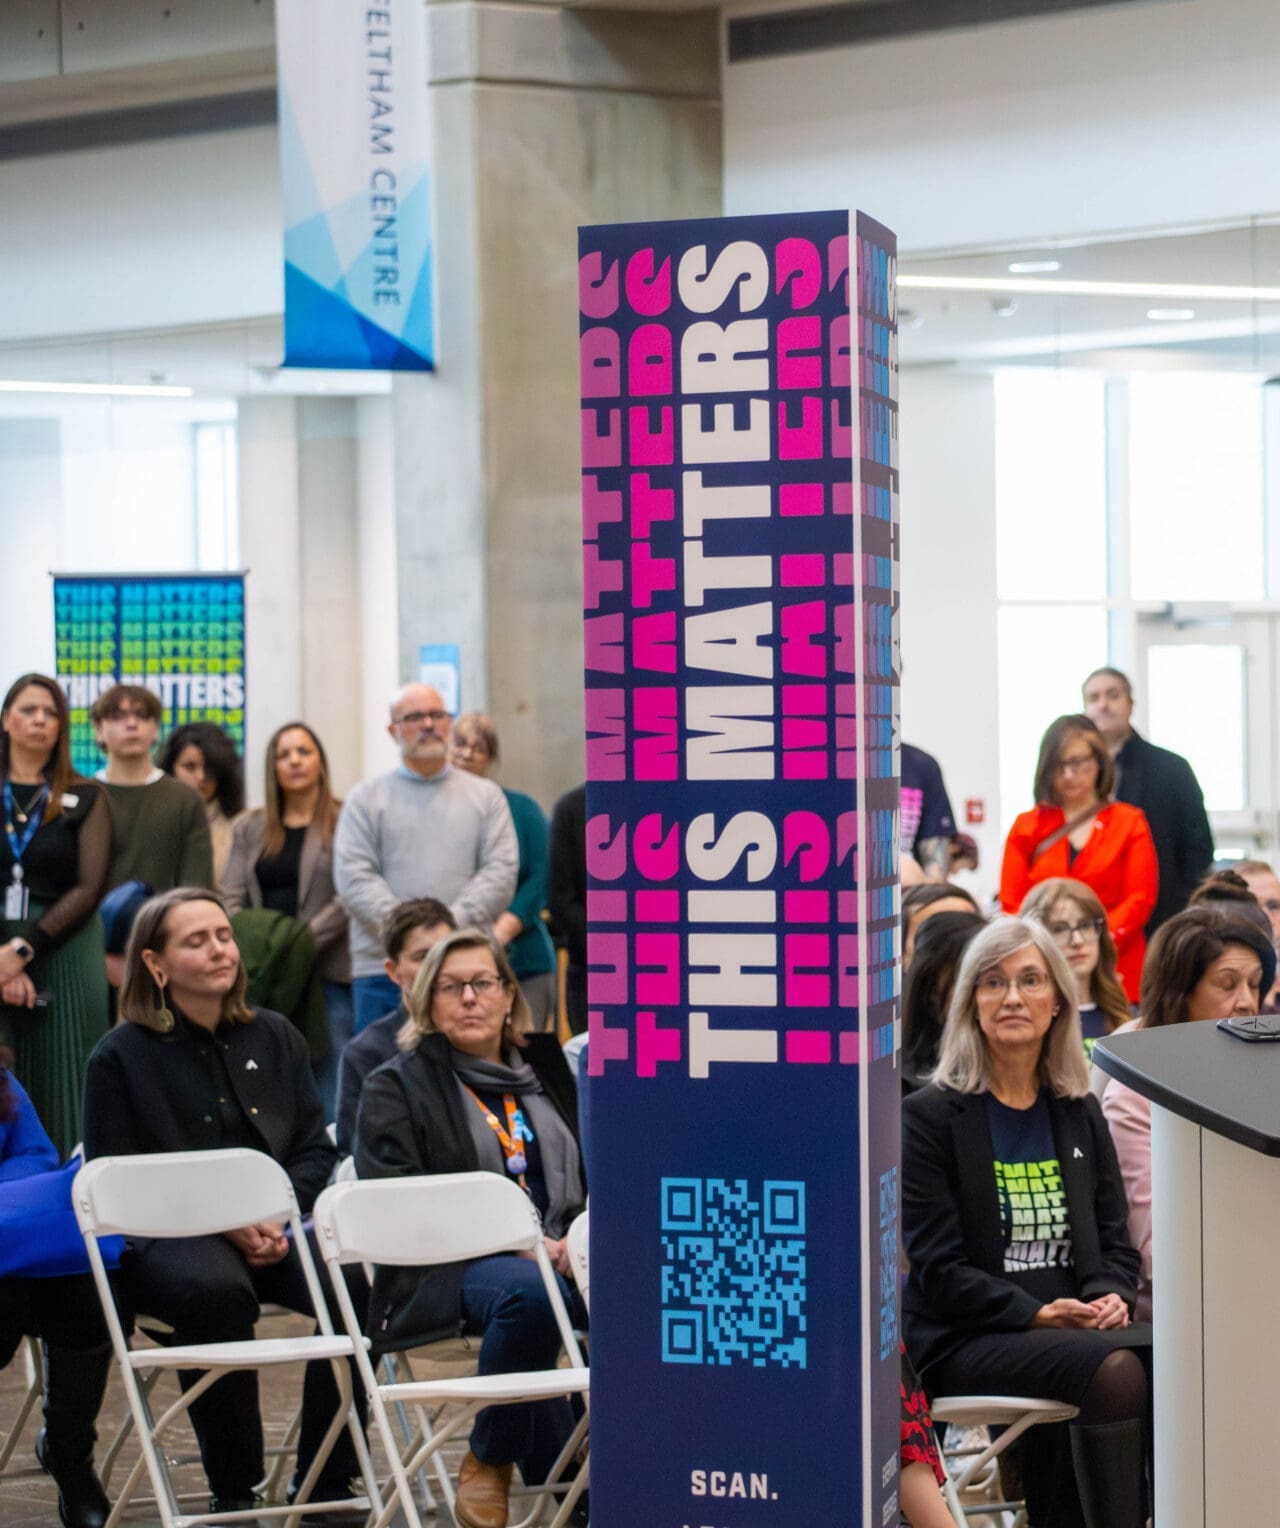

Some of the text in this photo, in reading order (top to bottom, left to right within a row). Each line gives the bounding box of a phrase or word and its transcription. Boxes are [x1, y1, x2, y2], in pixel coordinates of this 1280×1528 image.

[371, 168, 400, 306] CENTRE
[677, 240, 778, 1079] THIS MATTERS
[691, 1469, 778, 1500] SCAN.
